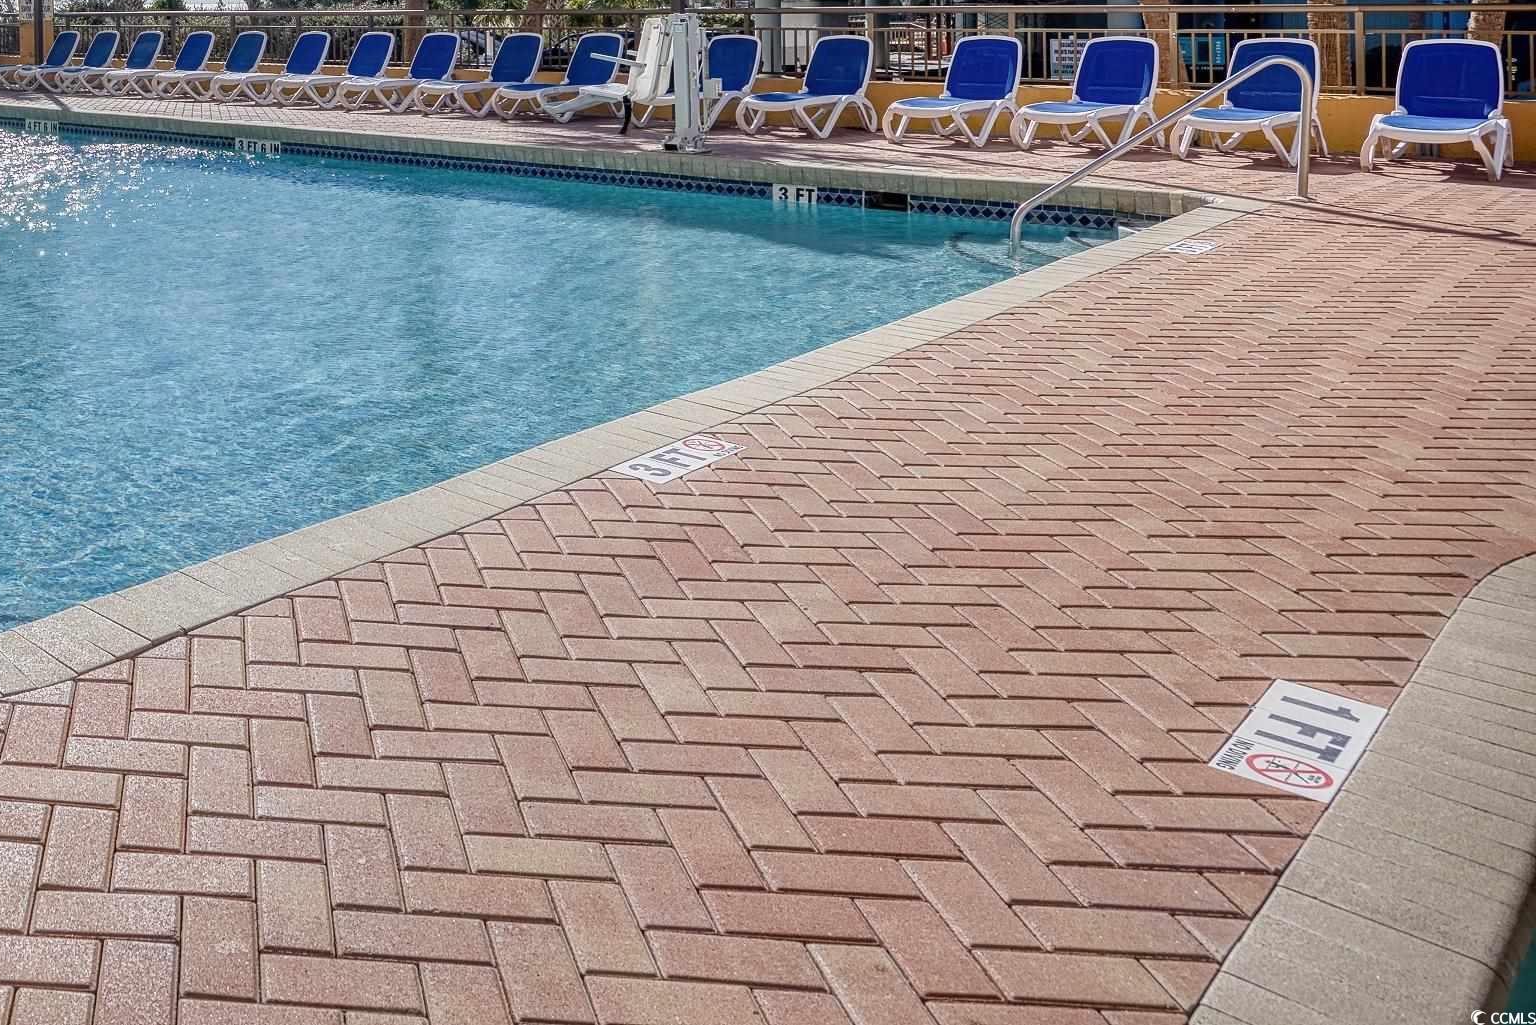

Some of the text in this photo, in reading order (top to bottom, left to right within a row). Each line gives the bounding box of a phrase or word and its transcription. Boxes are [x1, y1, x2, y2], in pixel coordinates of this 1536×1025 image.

[33, 121, 41, 131] FT
[50, 121, 58, 133] IN
[238, 139, 280, 154] 3 FT 6 IN
[778, 186, 816, 203] 3 FT
[648, 447, 707, 468] FT
[628, 462, 672, 477] 3
[1253, 695, 1361, 764] 1 FT
[1215, 736, 1256, 770] NO DIVING
